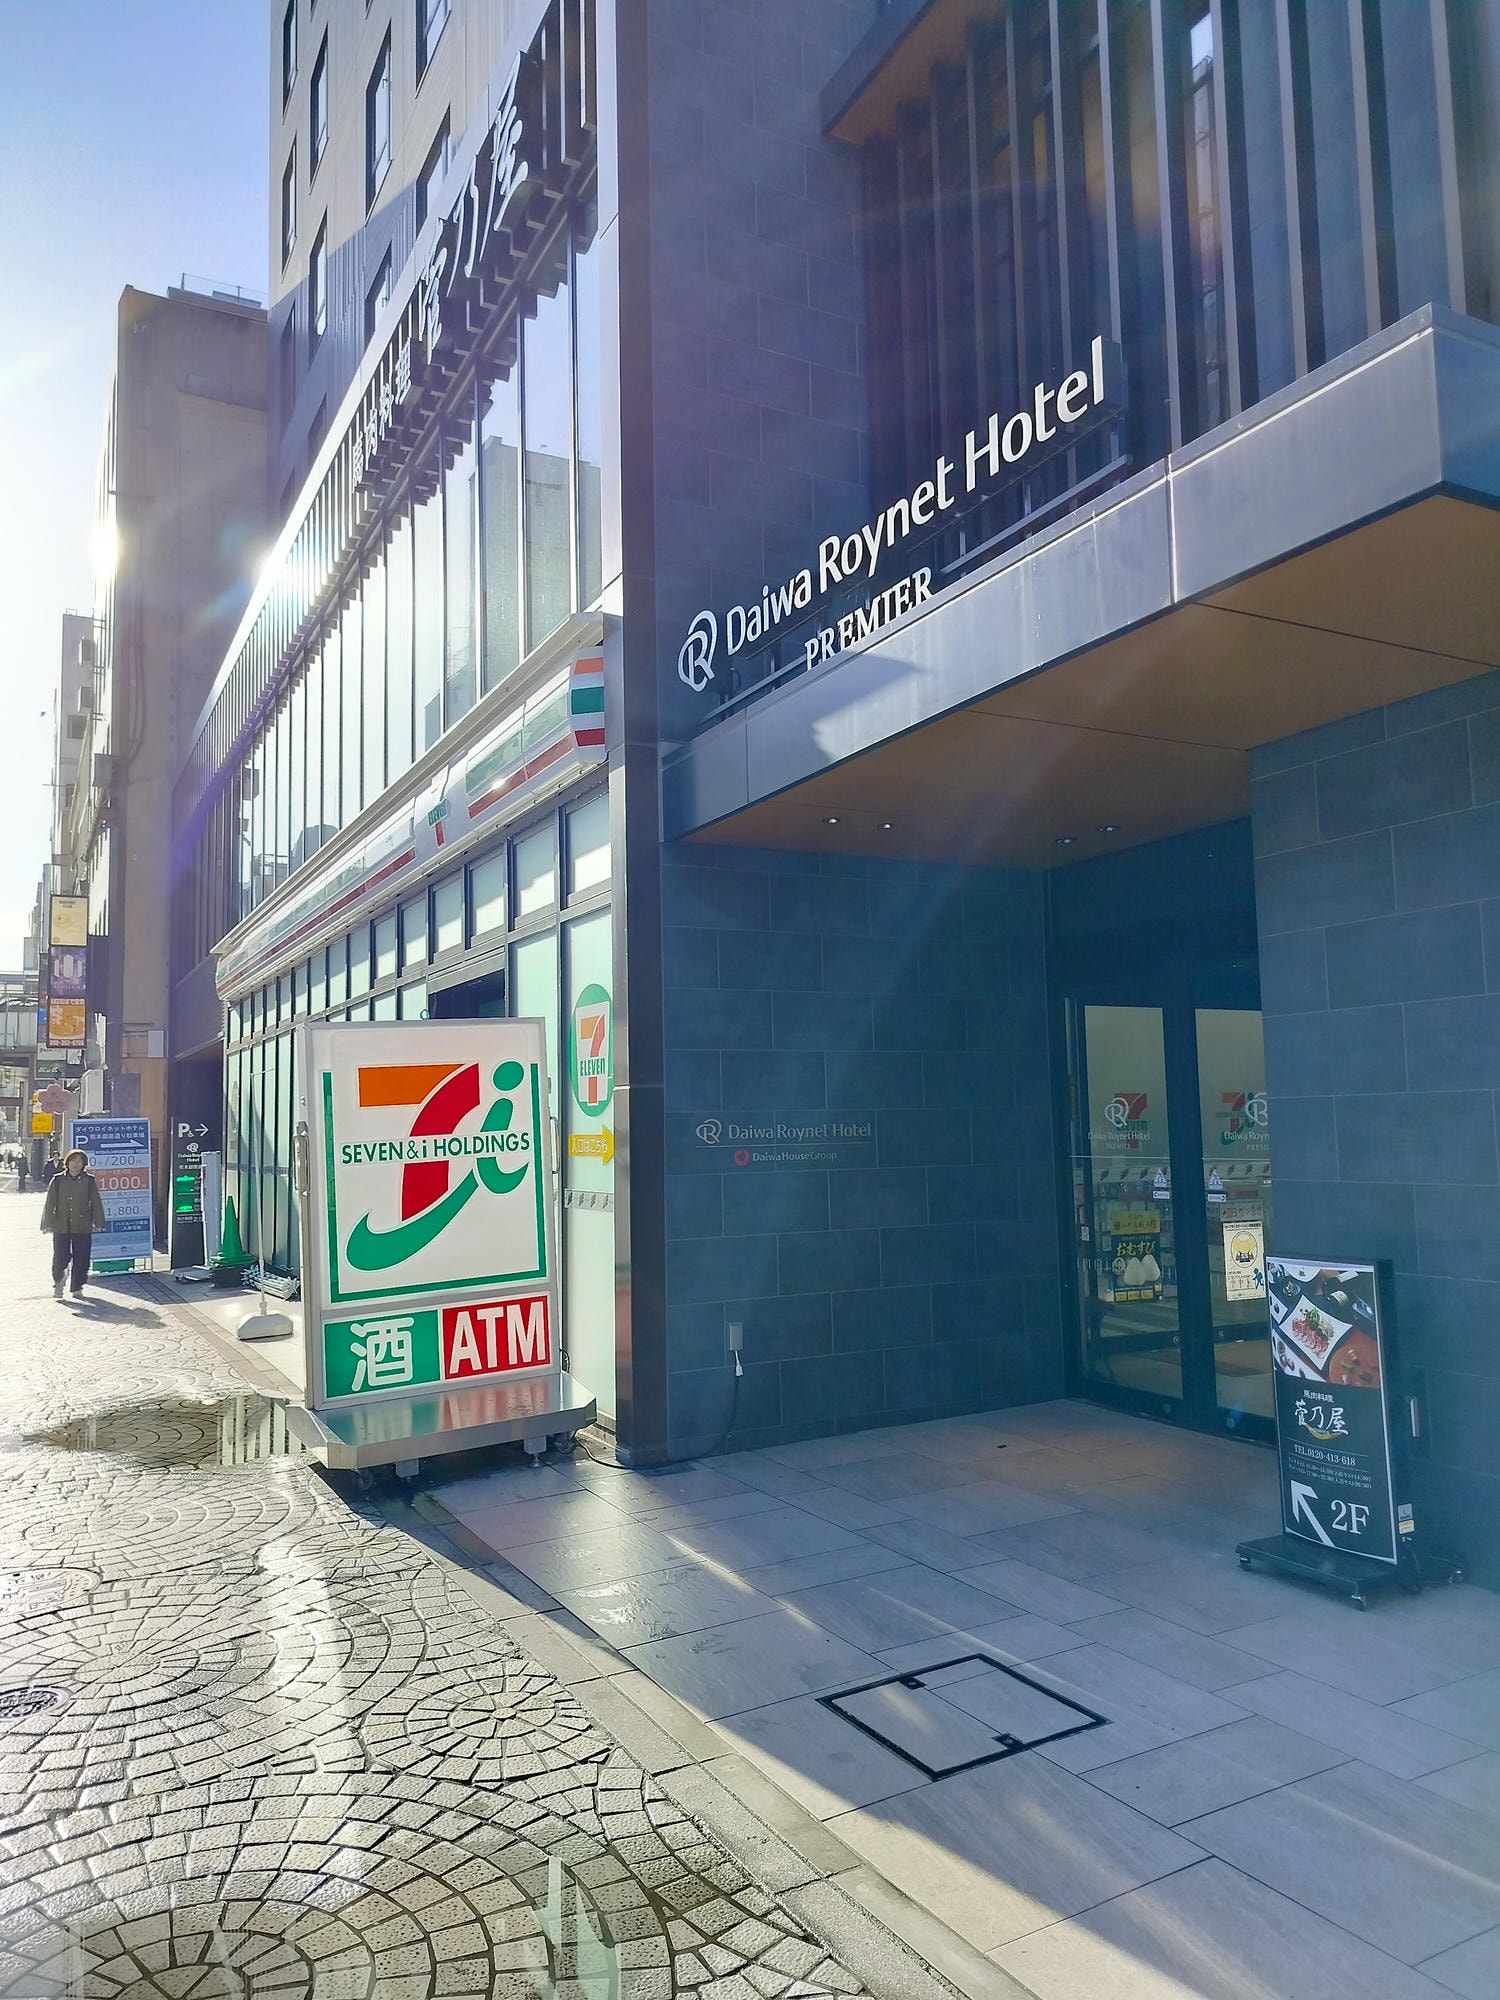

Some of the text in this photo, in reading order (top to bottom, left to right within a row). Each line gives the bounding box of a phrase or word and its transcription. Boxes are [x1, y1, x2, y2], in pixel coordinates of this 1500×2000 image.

[726, 569, 812, 656] Daiwa
[818, 456, 954, 593] Roynet
[965, 335, 1105, 493] Hotel
[805, 567, 933, 672] PREMIER
[579, 1057, 606, 1077] ELEVEN
[433, 1132, 531, 1158] HOLDINGS
[728, 1122, 871, 1142] Daiwa Roynet Hotel
[350, 1317, 415, 1392] 酒
[449, 1301, 548, 1375] ATM
[1303, 1389, 1335, 1403] 馬肉料理
[1294, 1399, 1349, 1435] 菅乃屋
[1330, 1499, 1370, 1535] 2F
